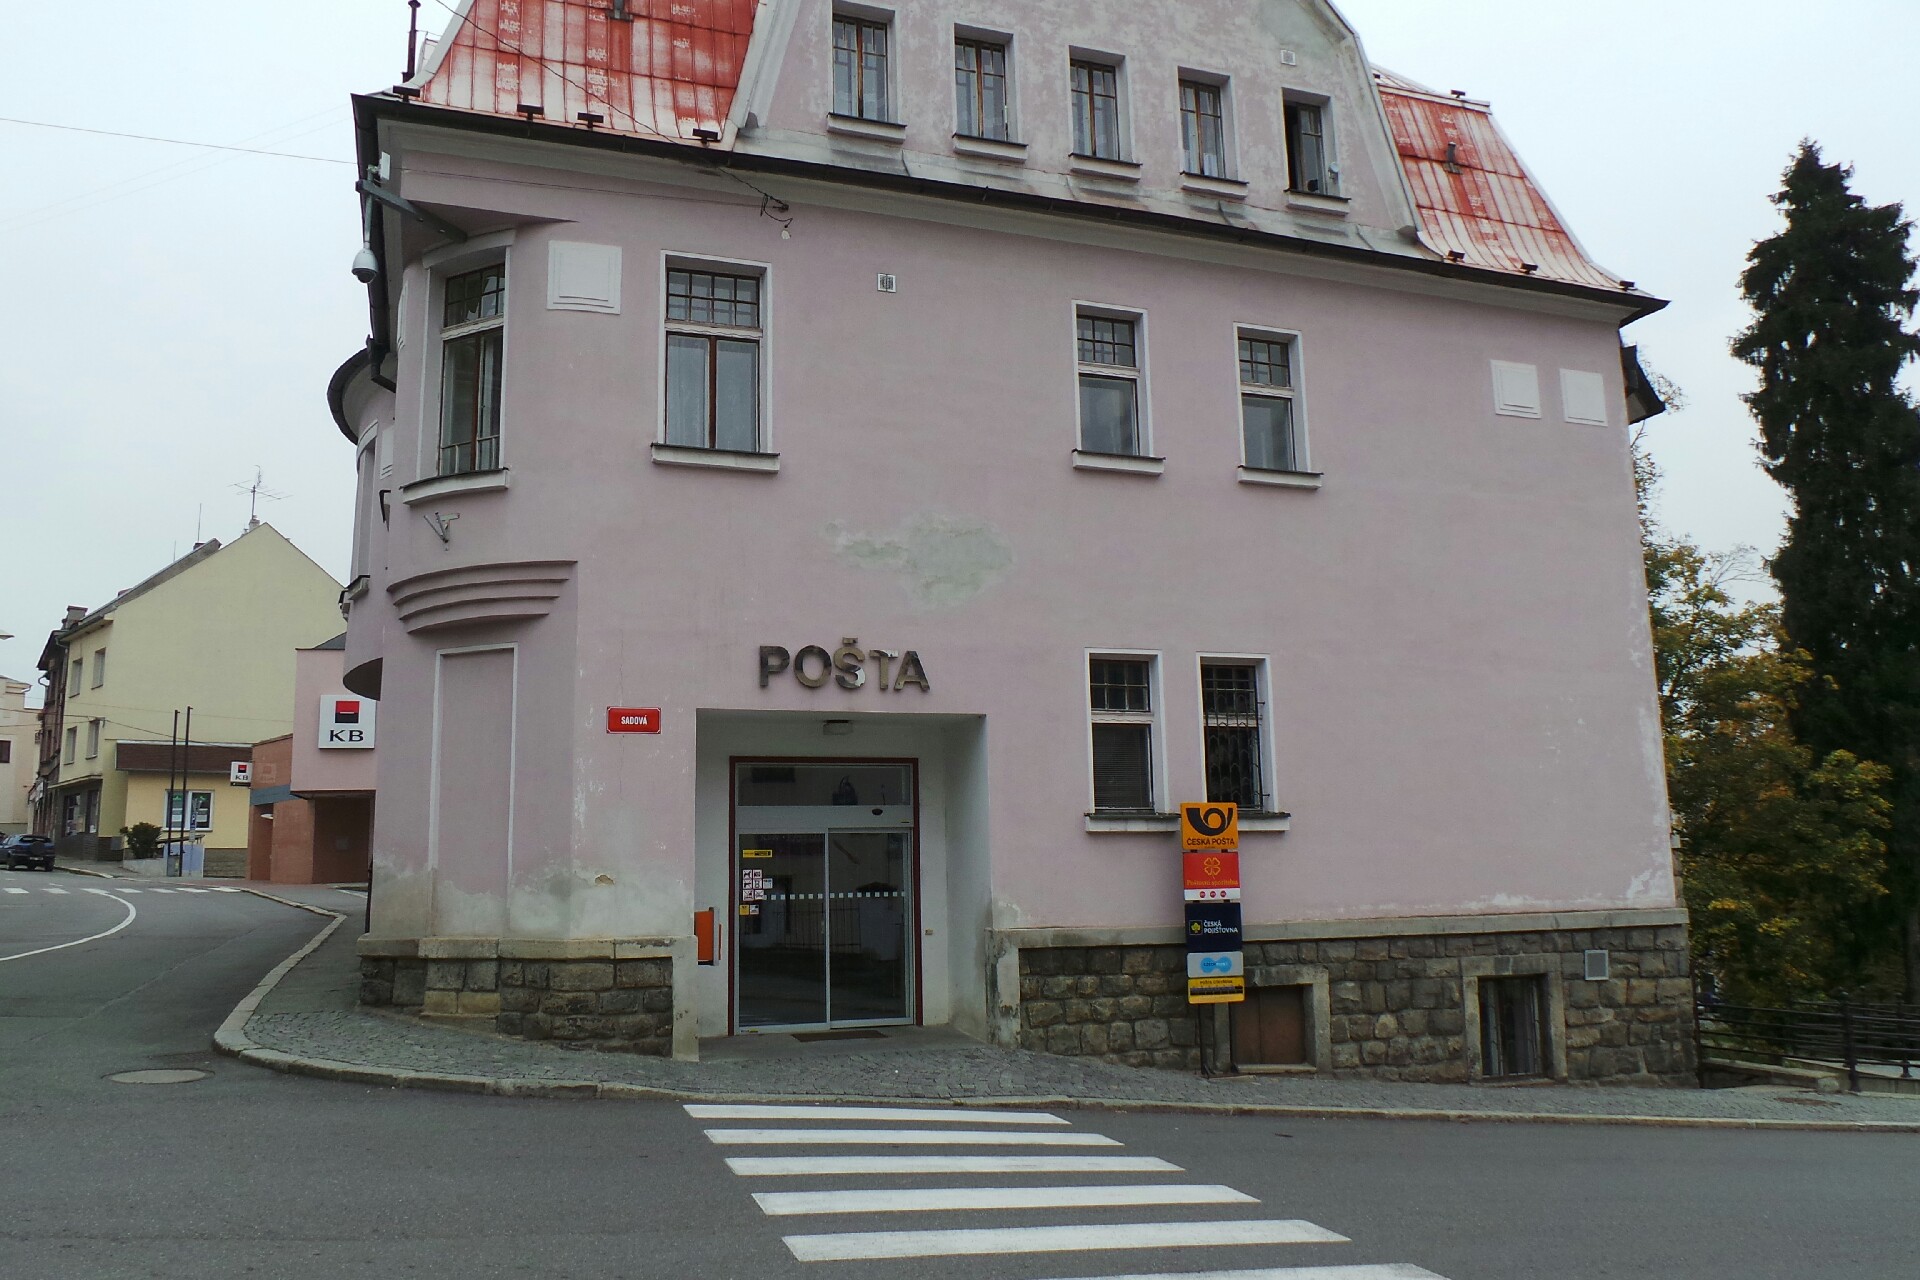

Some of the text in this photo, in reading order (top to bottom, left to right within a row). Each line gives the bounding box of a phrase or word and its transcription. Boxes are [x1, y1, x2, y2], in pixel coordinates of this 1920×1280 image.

[759, 637, 930, 692] POŠTA
[621, 714, 648, 726] SADOVÁ
[330, 729, 364, 742] KB
[1203, 919, 1222, 928] ČESKÁ
